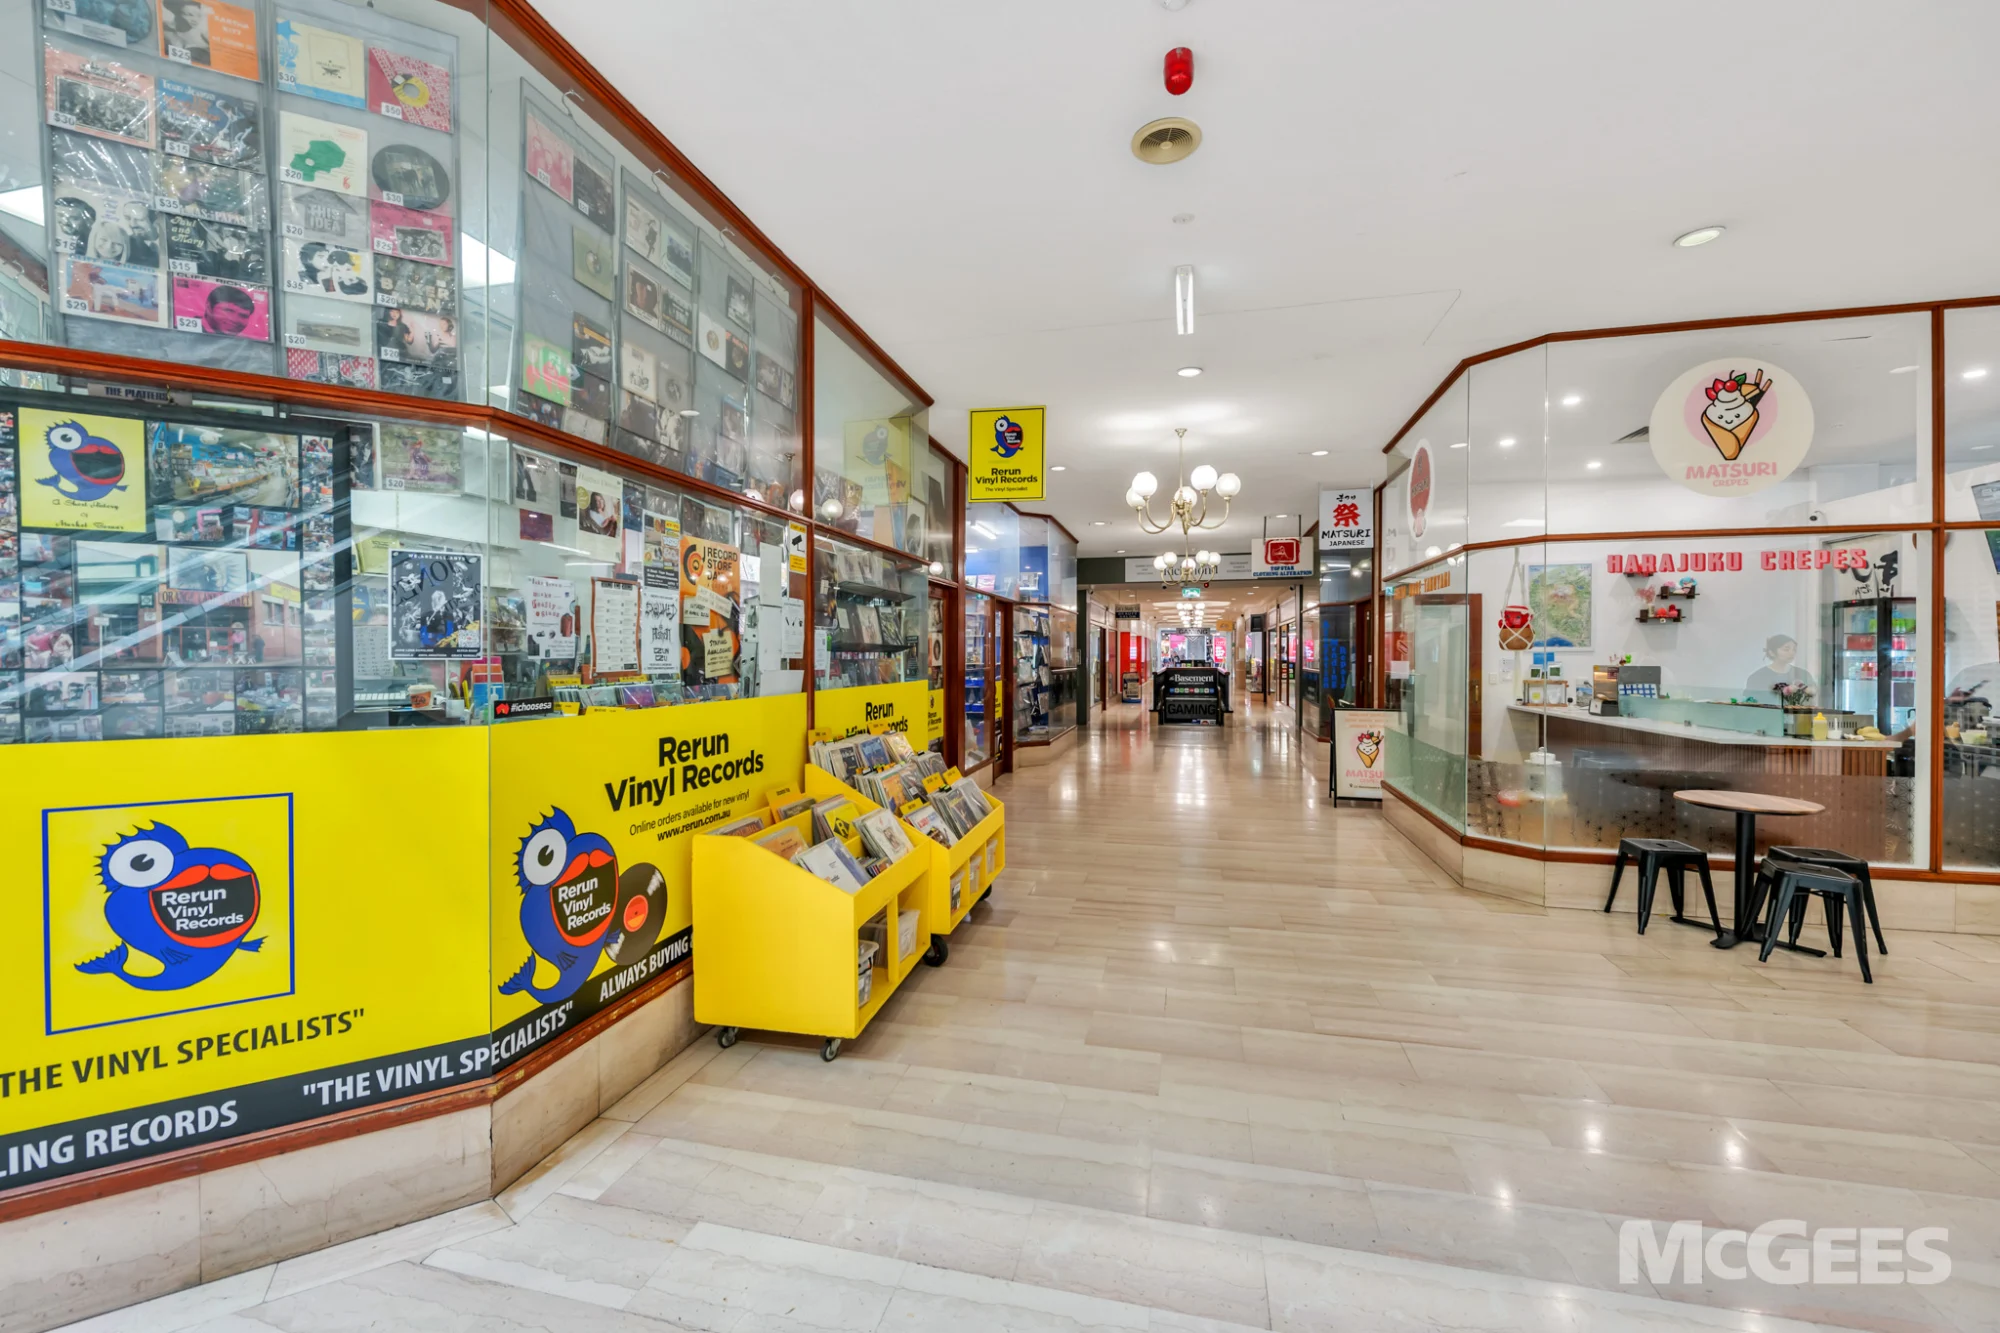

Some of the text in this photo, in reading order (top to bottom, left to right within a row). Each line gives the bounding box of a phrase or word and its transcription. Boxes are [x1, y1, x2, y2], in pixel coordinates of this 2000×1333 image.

[171, 48, 191, 60] $25
[279, 71, 295, 83] $30
[384, 104, 400, 116] $50
[53, 114, 75, 126] $30
[168, 142, 189, 154] $15
[285, 168, 302, 180] $20
[159, 196, 179, 209] $35
[170, 215, 197, 228] Paul
[310, 218, 341, 232] IDEA
[286, 225, 303, 236] $20
[56, 238, 76, 250] $15
[171, 233, 205, 248] Mary
[376, 240, 392, 250] $25
[171, 260, 191, 271] $15
[286, 280, 304, 291] $35
[66, 300, 87, 311] $29
[380, 294, 397, 305] $20
[178, 317, 198, 329] $29
[288, 335, 305, 345] $20
[383, 347, 399, 358] $20
[104, 386, 123, 397] THE
[991, 467, 1021, 476] Rerun
[1685, 461, 1777, 480] MATSURI
[388, 479, 403, 489] $20
[975, 475, 1038, 485] Vinyl Records
[1712, 478, 1749, 487] CREPES
[1333, 503, 1361, 527] 祭
[1321, 529, 1371, 539] MATSURI
[707, 547, 738, 562] RECORD
[707, 559, 732, 571] STORE
[1606, 548, 1867, 575] HARAJUKU CREPES
[1163, 564, 1219, 576] Ricond
[1174, 674, 1214, 682] Basement
[510, 701, 552, 712] #ichoosesa
[865, 701, 894, 722] Rerun
[1167, 703, 1216, 715] GAMING
[659, 732, 730, 767] Rerun
[1345, 769, 1384, 779] MATSU
[604, 749, 764, 812] Vinyl Records
[629, 788, 750, 836] Online orders available for new vinyl
[657, 809, 731, 842] www.rerun.com.au
[558, 877, 599, 903] Rerun
[161, 886, 227, 907] Rerun
[563, 894, 593, 917] Vinyl
[167, 903, 214, 921] Vinyl
[567, 902, 612, 931] Records
[175, 912, 245, 931] Records
[600, 936, 689, 1002] ALWAYS BUYING
[72, 1046, 168, 1084] VINYL
[177, 1007, 365, 1065] SPECIALISTS"
[303, 1000, 573, 1106] "THE VINYL SPECIALISTS"
[86, 1099, 239, 1158] RECORDS
